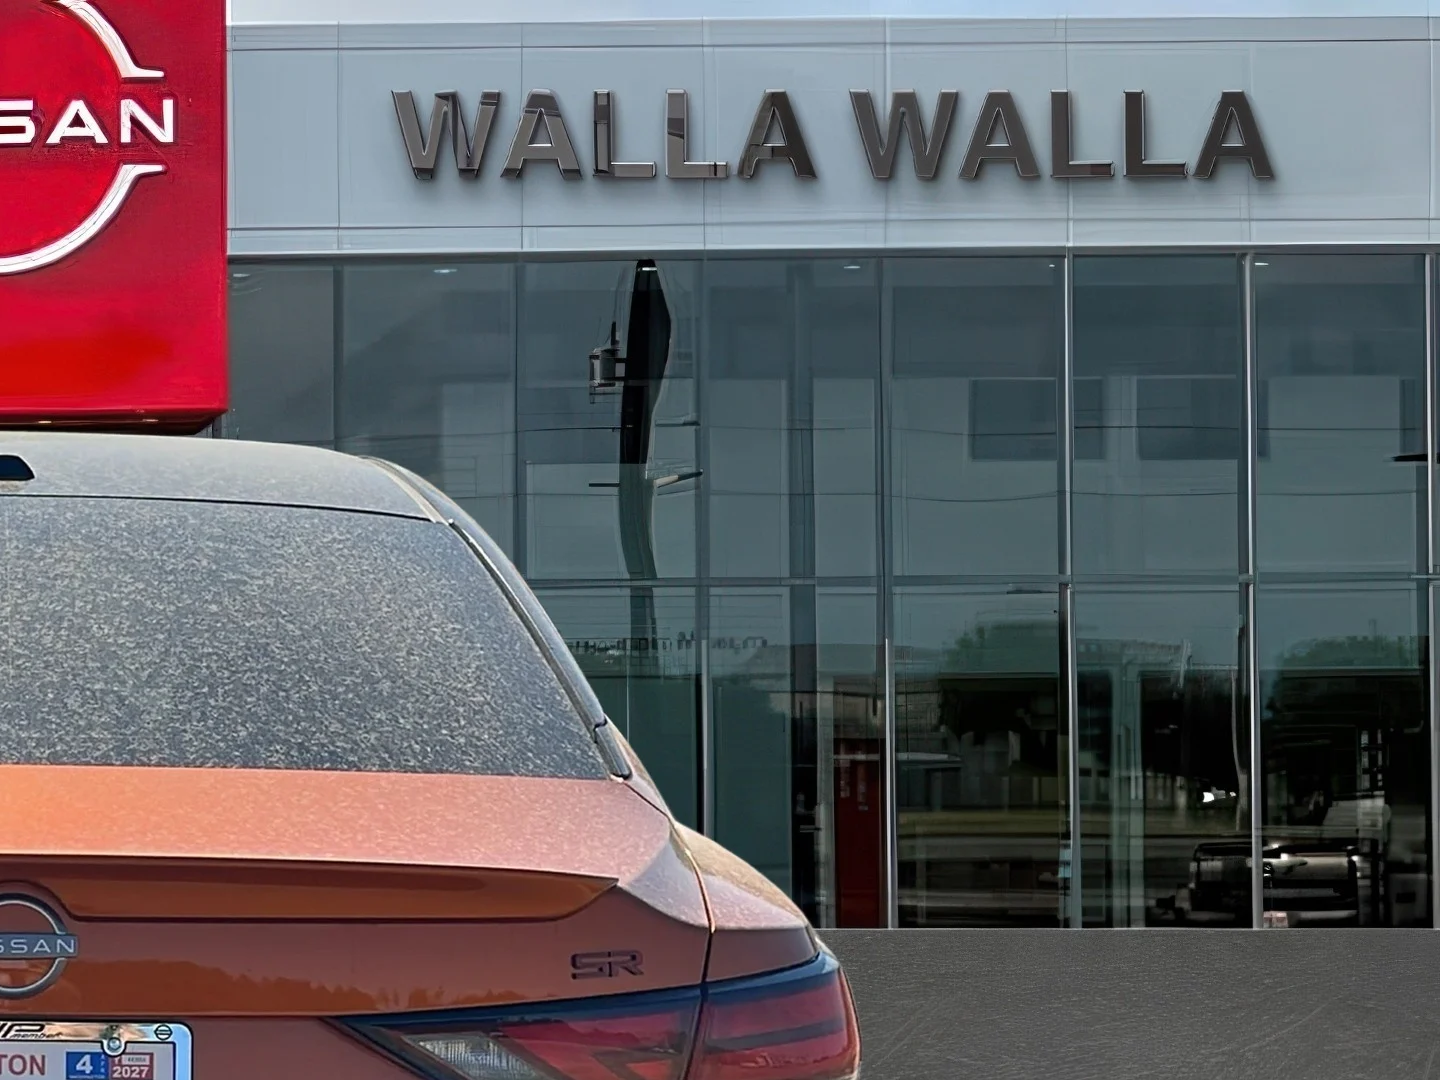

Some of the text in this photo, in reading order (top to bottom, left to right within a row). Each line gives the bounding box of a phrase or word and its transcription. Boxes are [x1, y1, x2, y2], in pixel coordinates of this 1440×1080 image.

[391, 89, 1276, 180] WALLA WALLA
[571, 950, 644, 980] SR
[76, 1055, 93, 1074] 4
[112, 1066, 149, 1079] 2027
